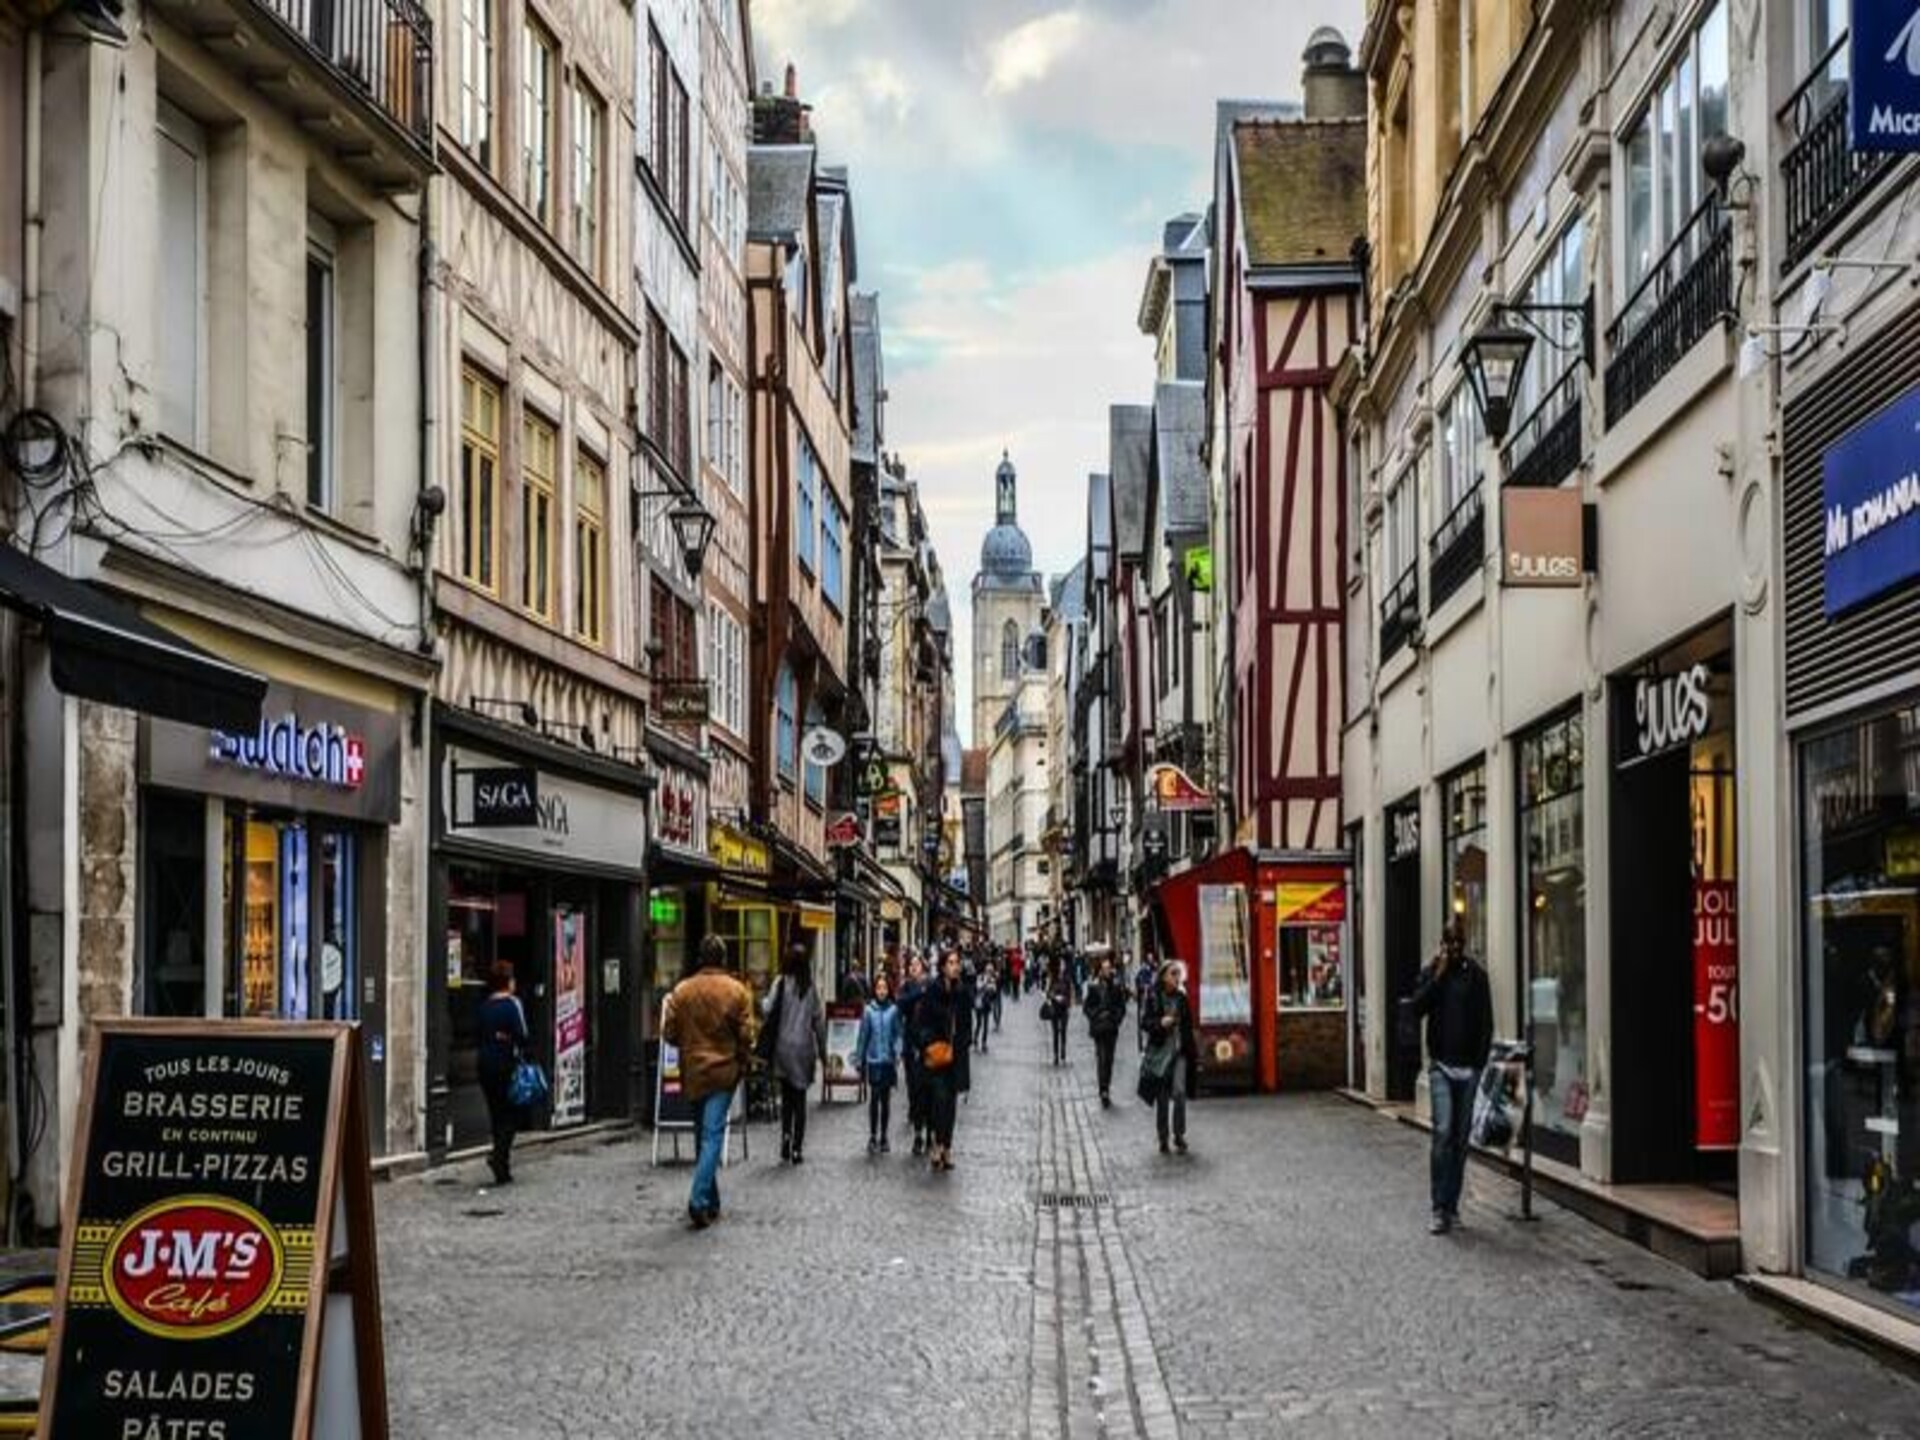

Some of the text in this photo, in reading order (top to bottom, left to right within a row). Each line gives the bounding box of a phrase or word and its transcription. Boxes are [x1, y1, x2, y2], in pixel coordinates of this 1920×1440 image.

[144, 1056, 290, 1085] TOUS LES JOURS
[123, 1091, 304, 1120] BRASSERIE
[162, 1128, 258, 1143] EN CONTINU
[104, 1369, 255, 1400] SALADES
